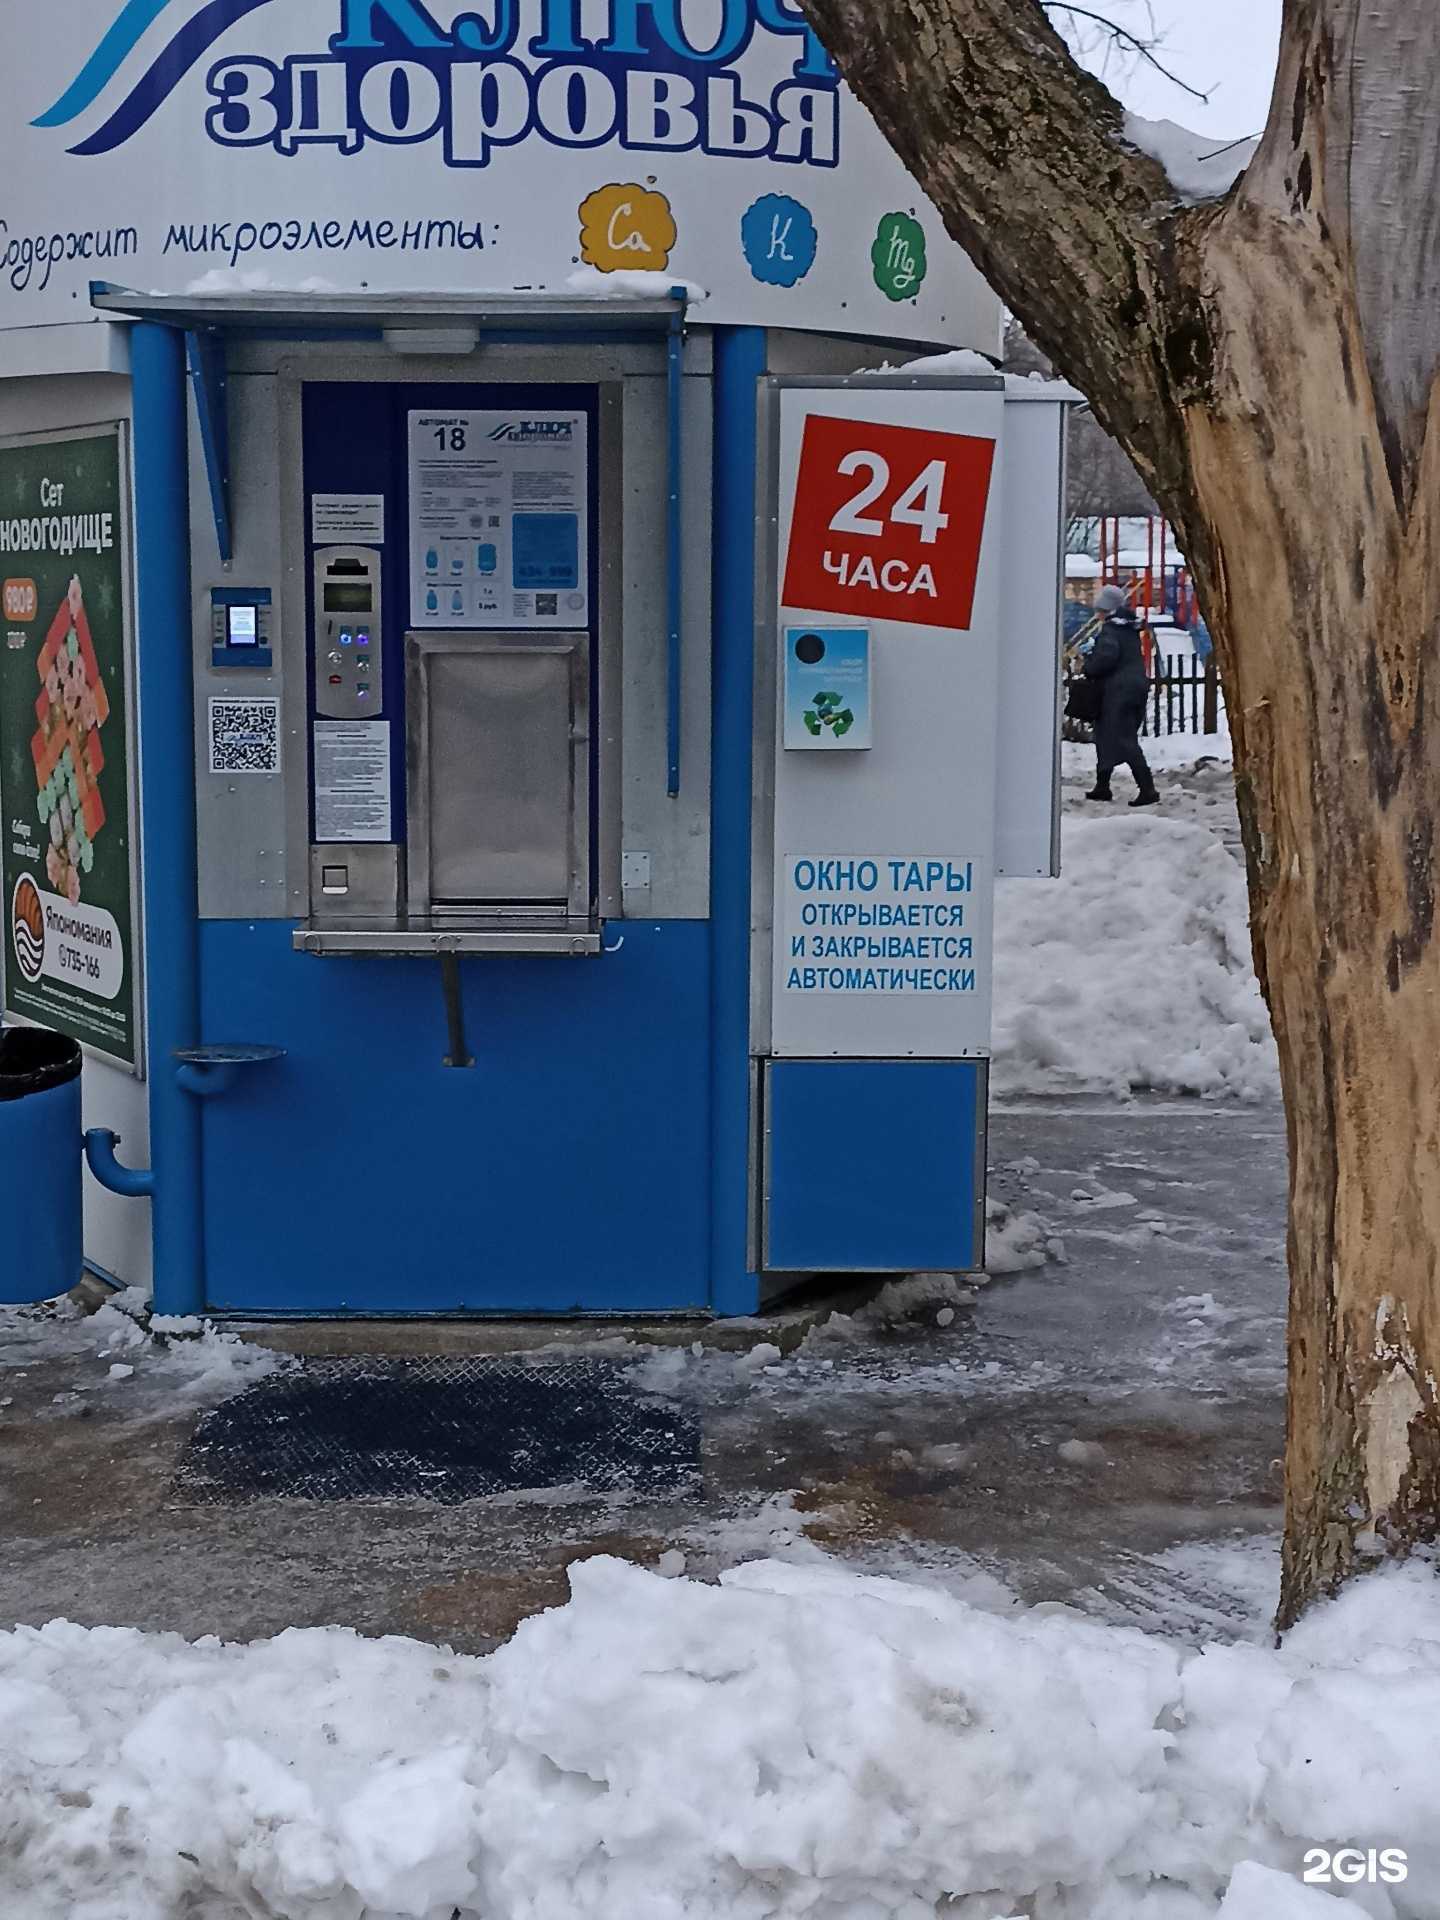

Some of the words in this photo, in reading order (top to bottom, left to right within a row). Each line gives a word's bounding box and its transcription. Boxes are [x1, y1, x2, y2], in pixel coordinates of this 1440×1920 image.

[207, 55, 839, 166] здоровья
[163, 219, 500, 267] микроэлементы:
[433, 427, 466, 451] 18
[40, 477, 64, 507] Сет
[828, 450, 949, 544] 24
[0, 513, 113, 555] НОВОГОДИЩЕ
[823, 550, 938, 598] ЧАСА
[794, 860, 878, 891] ОКНО
[888, 861, 973, 892] ТАРЫ
[46, 904, 113, 949] Япономания
[802, 903, 963, 926] ОТКРЫВАЕТСЯ
[792, 936, 805, 957] И
[812, 935, 972, 958] ЗАКРЫВАЕТСЯ
[787, 967, 976, 990] АВТОМАТИЧЕСКИ
